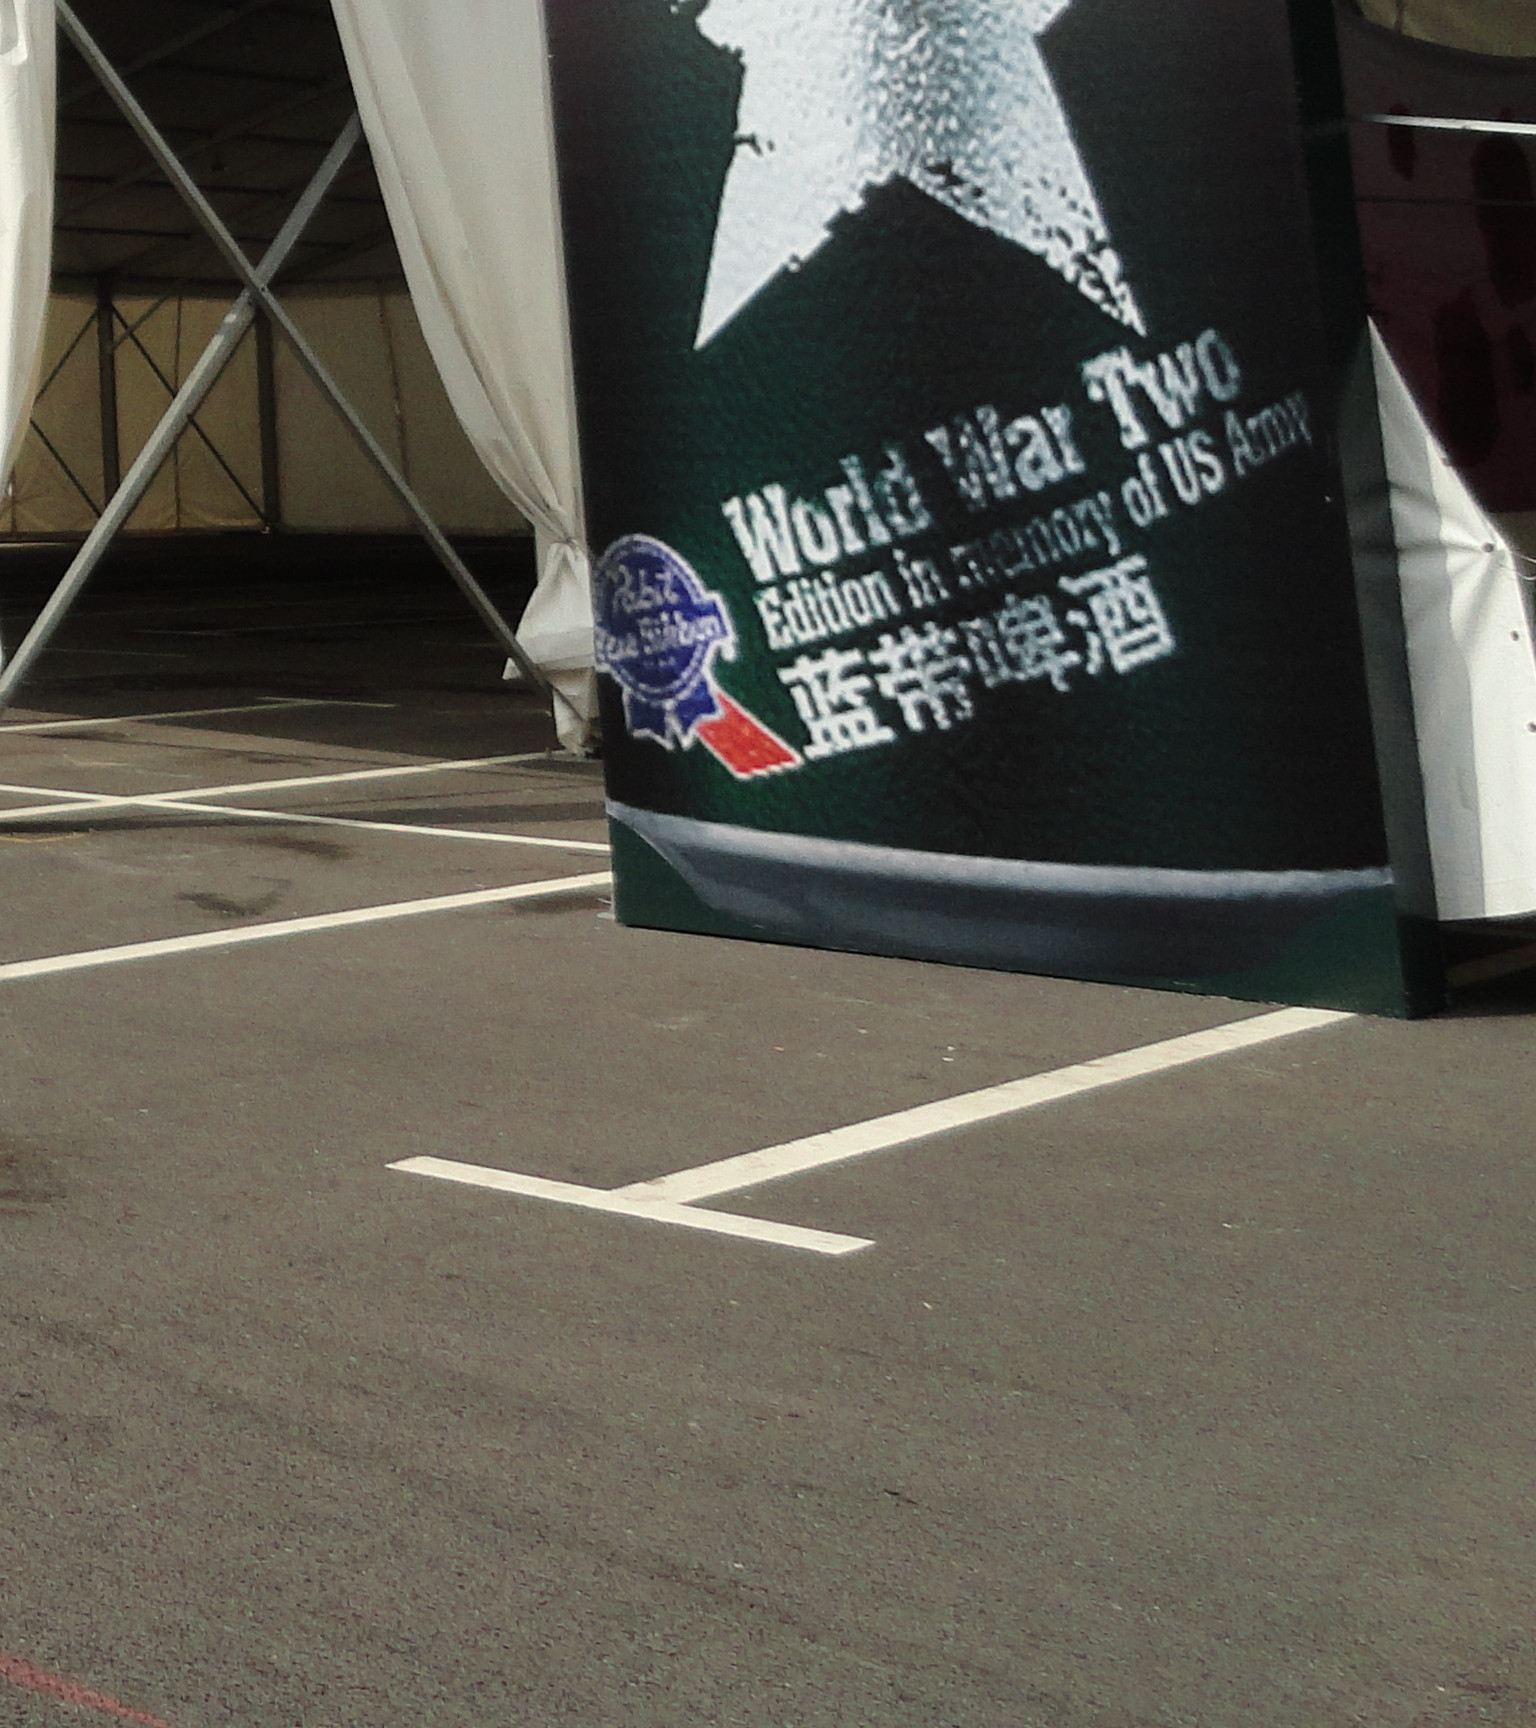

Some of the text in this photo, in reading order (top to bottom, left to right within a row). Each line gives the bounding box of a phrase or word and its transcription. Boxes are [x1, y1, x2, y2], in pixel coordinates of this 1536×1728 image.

[720, 327, 1241, 584] World War Two
[753, 390, 1314, 651] Edition in memory of US Army
[776, 553, 1176, 760] 蓝带啤酒
